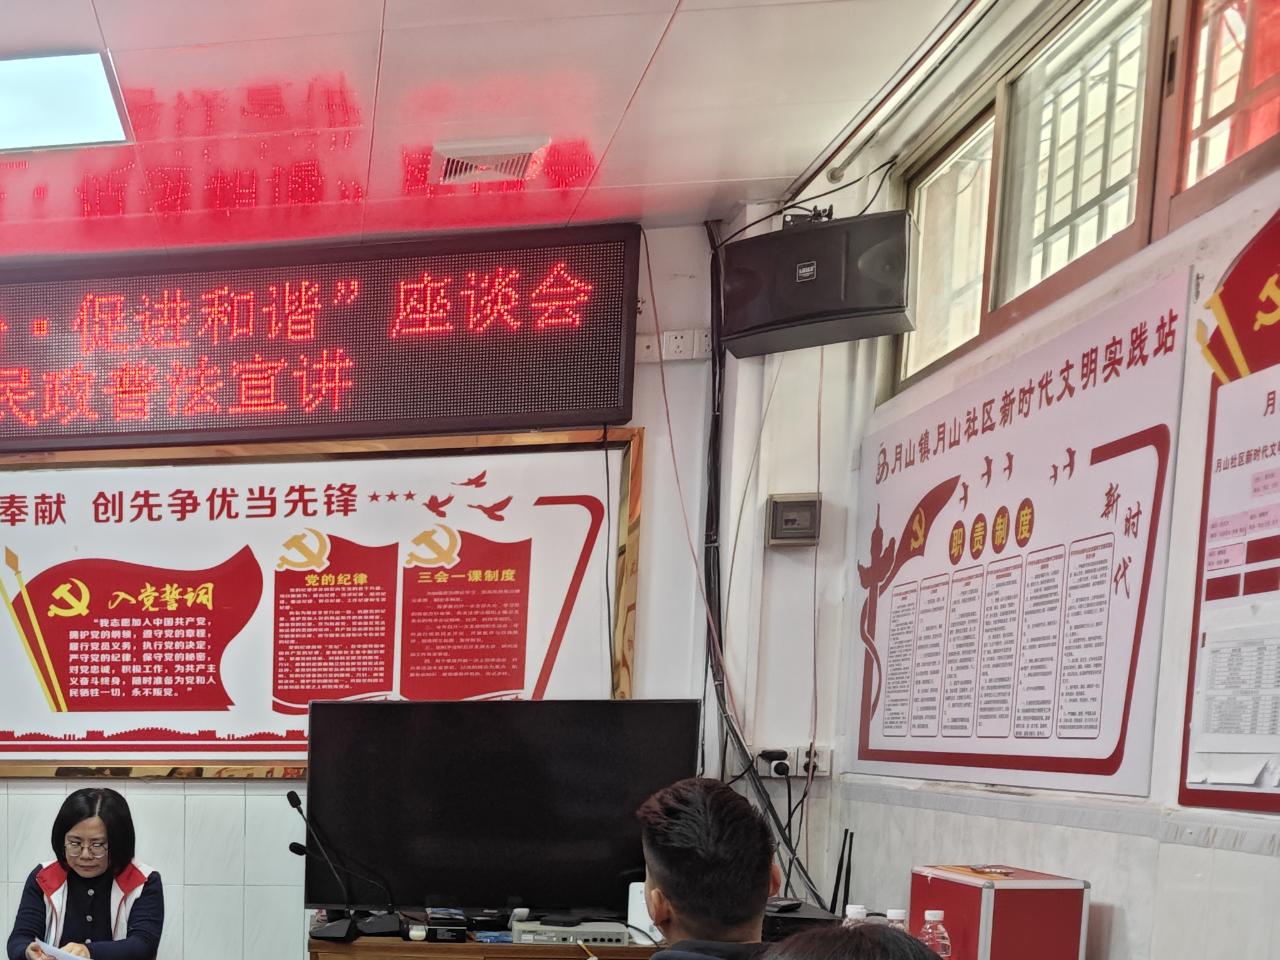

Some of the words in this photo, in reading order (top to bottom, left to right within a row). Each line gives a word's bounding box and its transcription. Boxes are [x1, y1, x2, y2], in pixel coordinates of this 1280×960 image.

[389, 261, 594, 339] 座谈会
[891, 308, 1178, 477] 月山镇月山社区新时代文明实践站
[1215, 440, 1280, 473] 月山社区新时代文
[91, 482, 358, 524] 创先争优当先锋
[950, 506, 1034, 558] 职责制度
[304, 572, 368, 587] 党的纪律
[417, 568, 516, 584] 三会一课制度
[108, 582, 215, 611] 入党誓词
